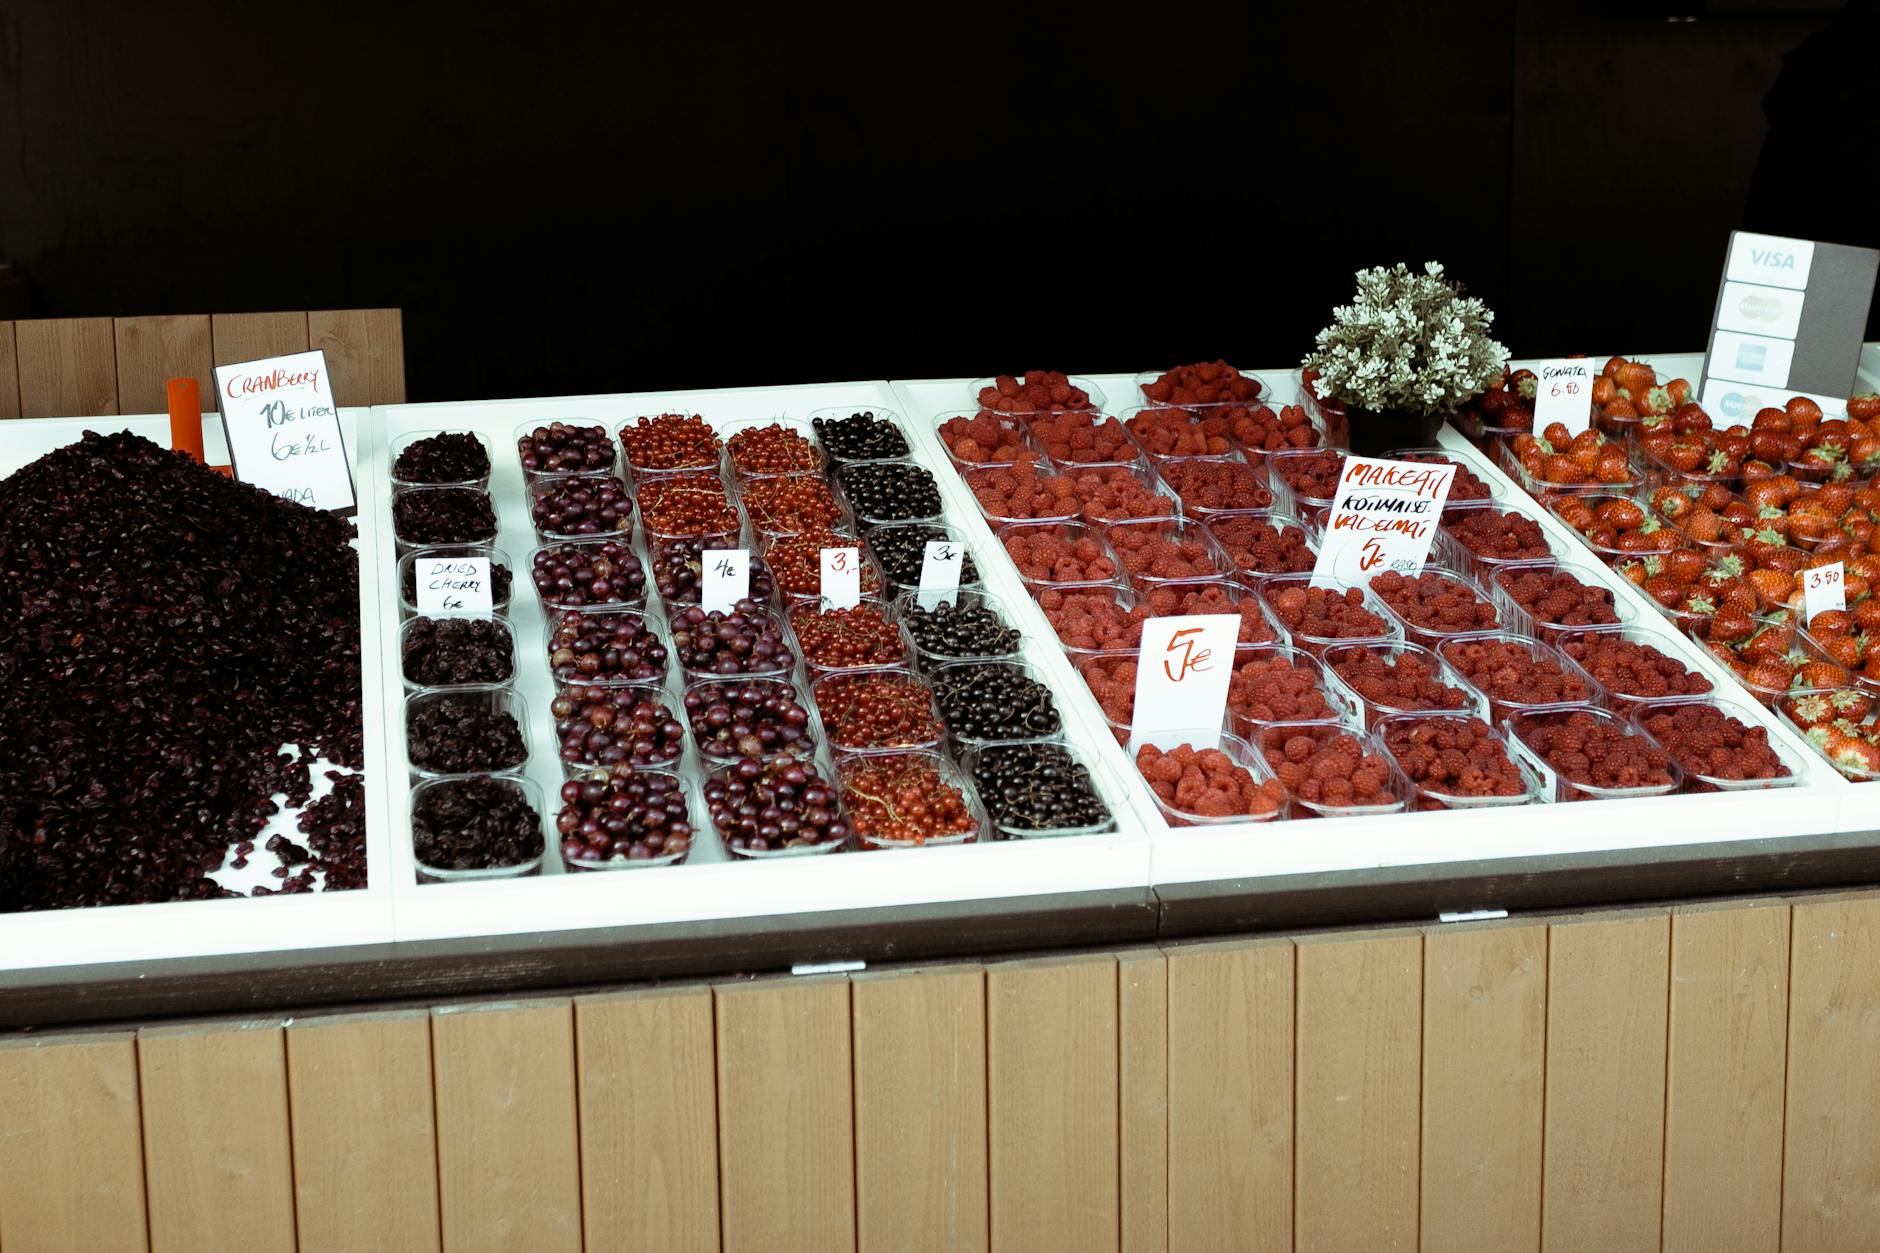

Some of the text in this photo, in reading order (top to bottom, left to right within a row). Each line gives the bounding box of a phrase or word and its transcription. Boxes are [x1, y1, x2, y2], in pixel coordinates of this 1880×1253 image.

[1751, 249, 1795, 269] VISA
[1543, 365, 1588, 380] SONATA
[227, 369, 319, 398] CRANBERRY
[430, 563, 477, 577] DRIED
[429, 577, 481, 593] CHERRY
